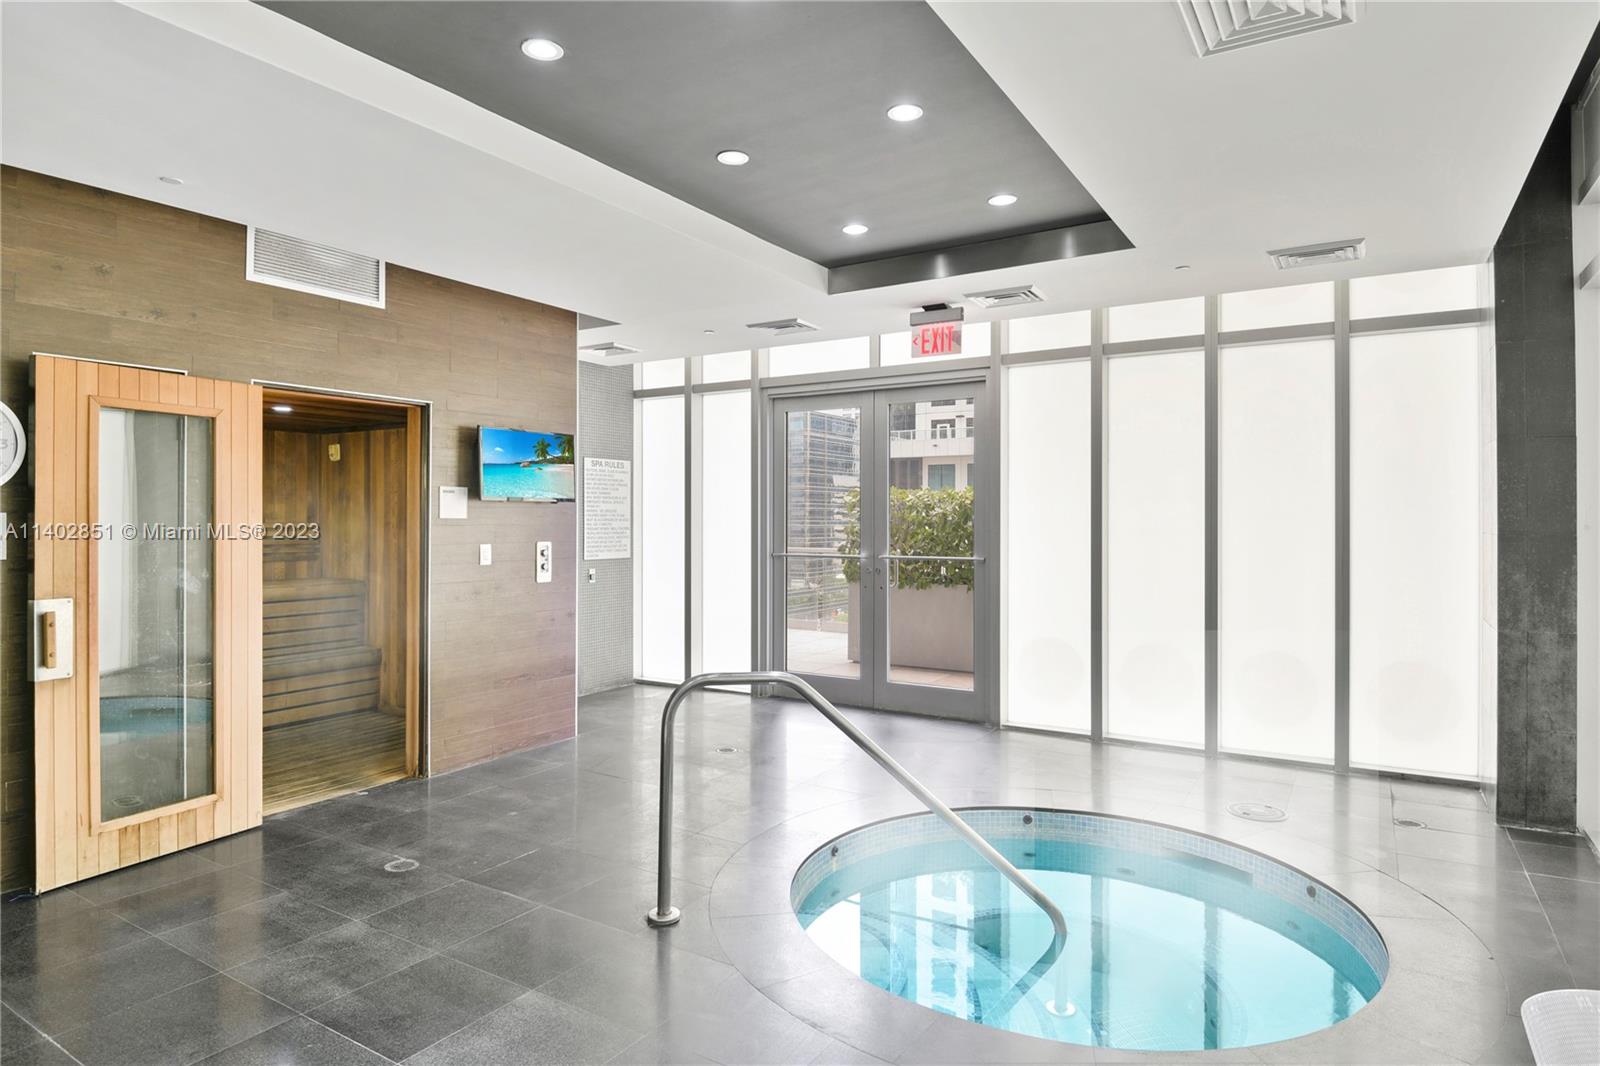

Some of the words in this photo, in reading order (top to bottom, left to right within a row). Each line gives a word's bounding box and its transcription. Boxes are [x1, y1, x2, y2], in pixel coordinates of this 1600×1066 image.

[921, 325, 954, 354] EXIT
[591, 459, 603, 468] SPA
[604, 460, 625, 469] RULES
